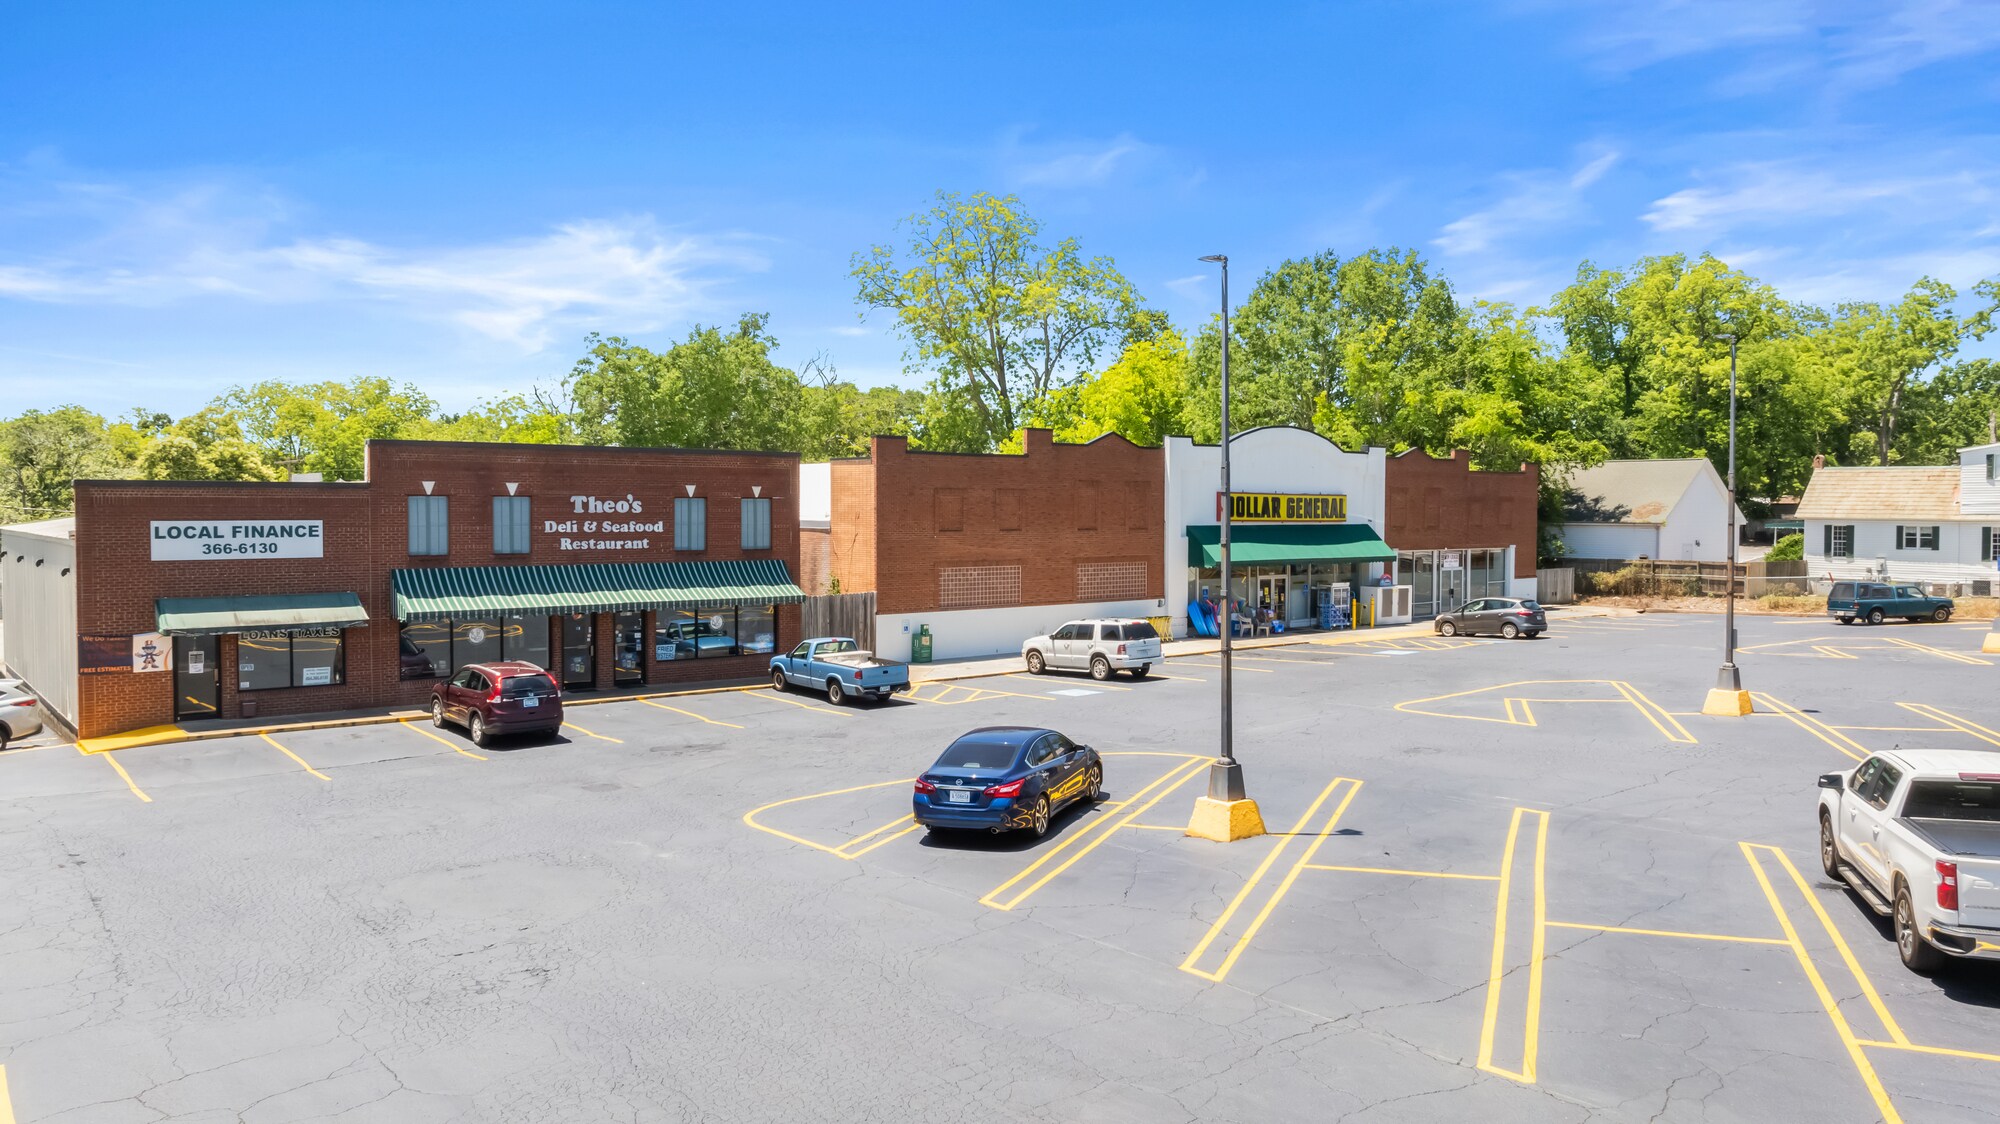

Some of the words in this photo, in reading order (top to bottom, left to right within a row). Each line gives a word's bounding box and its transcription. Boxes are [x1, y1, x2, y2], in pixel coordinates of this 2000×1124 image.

[570, 494, 642, 513] Theo's
[1286, 498, 1346, 519] GENERAL
[154, 525, 225, 540] LOCAL
[231, 525, 320, 538] FINANCE
[544, 520, 578, 533] Deli
[583, 521, 597, 533] &
[601, 521, 664, 533] Seafood
[202, 542, 278, 555] 366-6130
[560, 538, 649, 550] Restaurant
[240, 629, 288, 640] LOANS
[297, 627, 340, 638] TAXES
[97, 665, 132, 673] ESTIMATES
